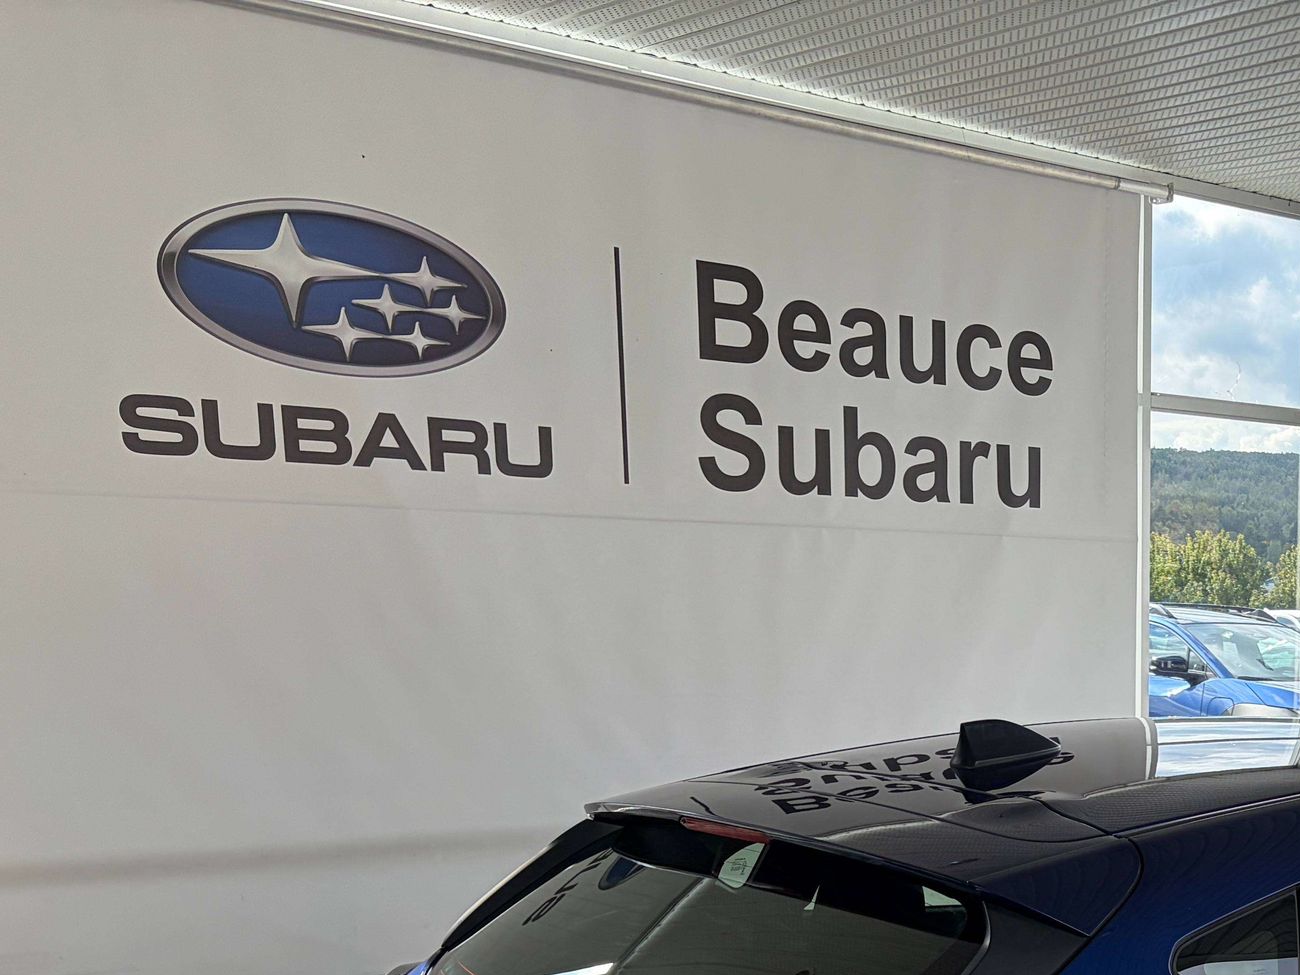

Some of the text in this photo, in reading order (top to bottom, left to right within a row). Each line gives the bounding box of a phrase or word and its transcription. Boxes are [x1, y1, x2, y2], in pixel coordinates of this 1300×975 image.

[695, 259, 1054, 397] Beauce
[118, 393, 554, 479] SUBARU
[698, 392, 1042, 509] Subaru
